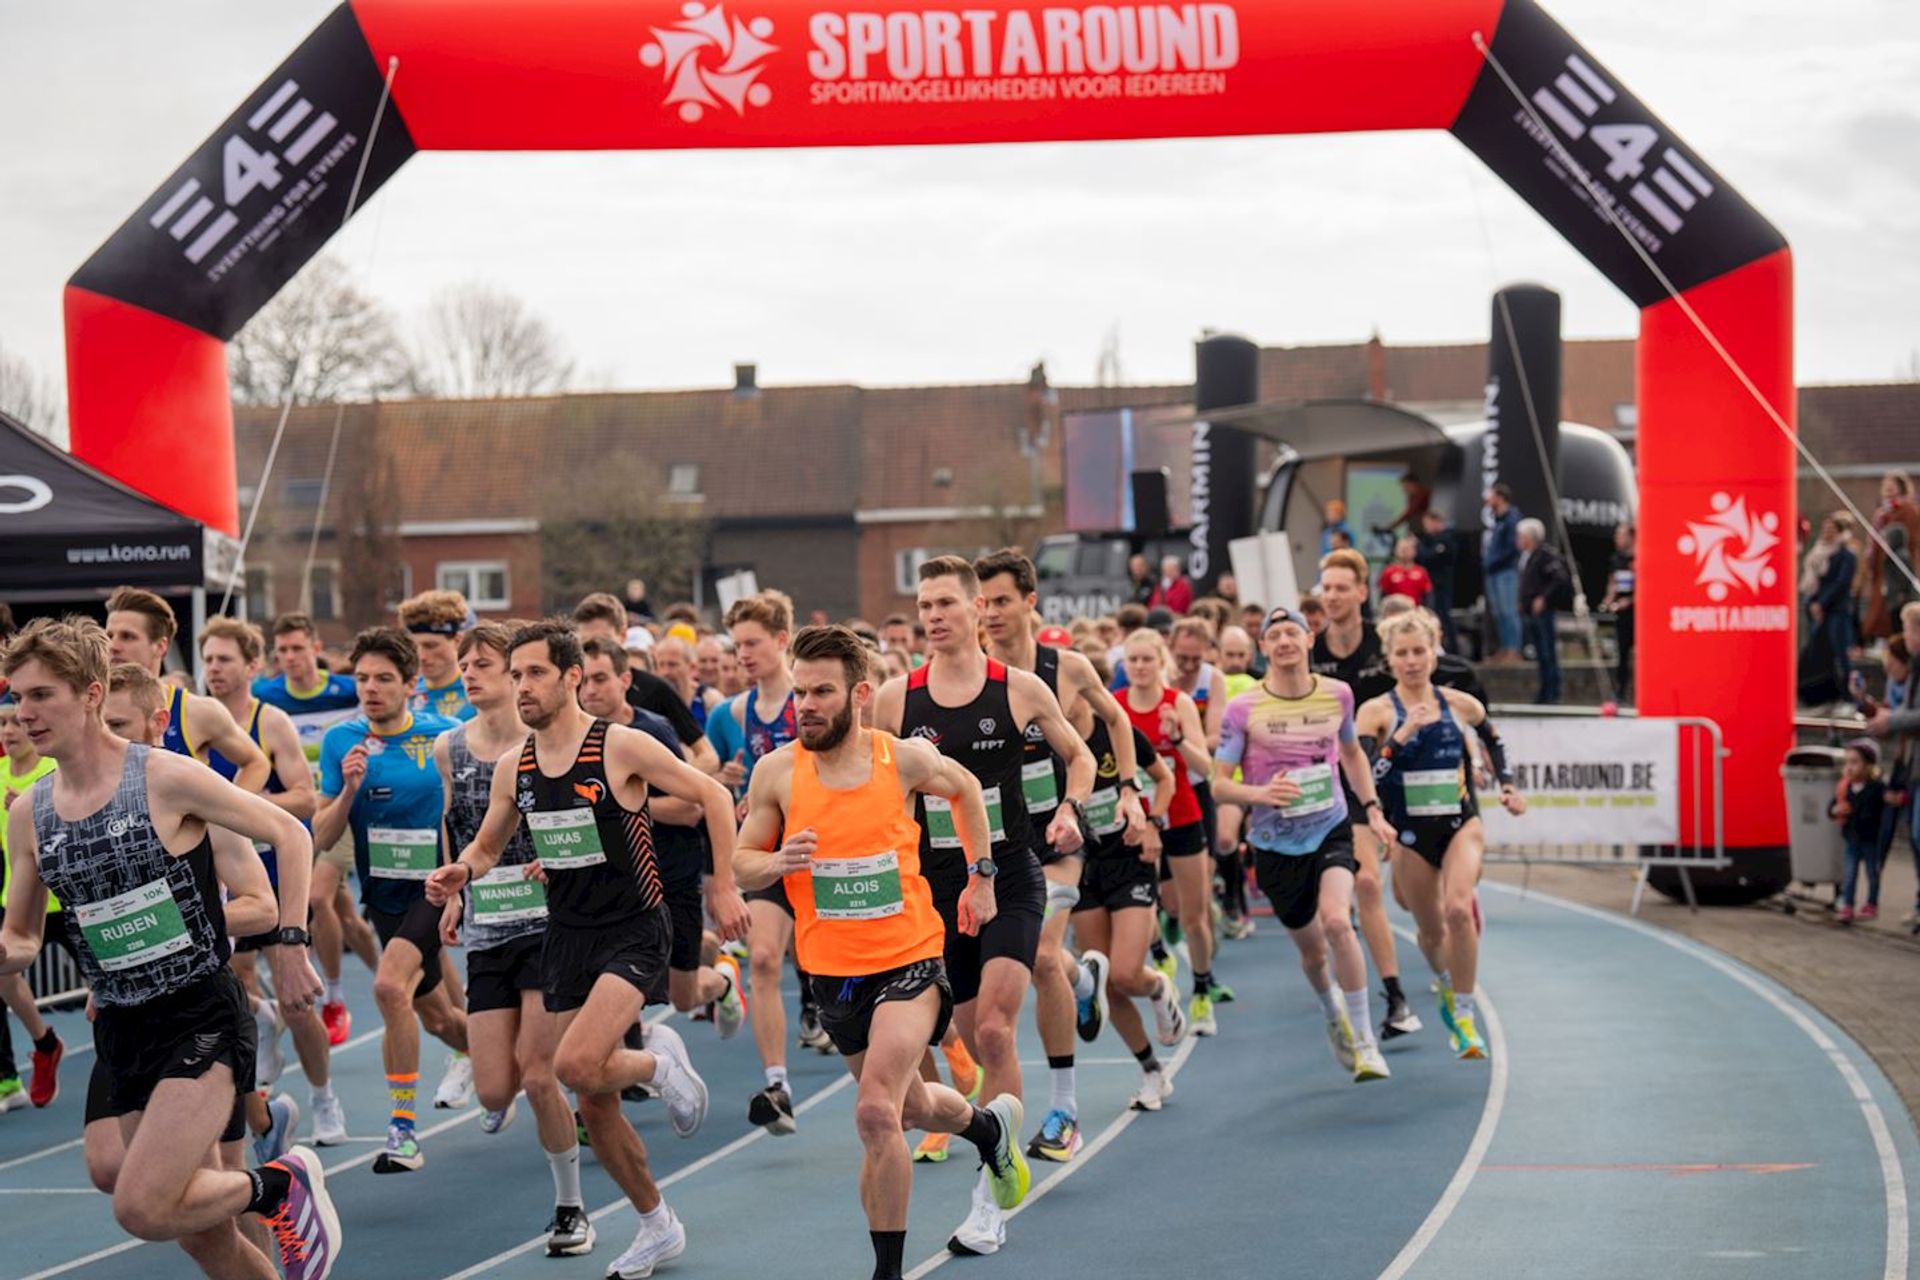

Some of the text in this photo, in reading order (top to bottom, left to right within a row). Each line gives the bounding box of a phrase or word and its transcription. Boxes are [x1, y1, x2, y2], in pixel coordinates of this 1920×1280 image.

[807, 3, 1239, 81] SPORTAROUND
[810, 72, 1226, 104] SPORTMOGELIJKHEDEN VOOR IEDEREEN
[1187, 421, 1211, 580] GARMIN
[67, 544, 190, 563] www.kono.run
[543, 831, 582, 845] LUKAS
[391, 847, 412, 859] TIM
[142, 886, 165, 901] 10K
[480, 884, 533, 901] WANNES
[833, 880, 880, 895] ALOIS
[100, 913, 158, 942] RUBEN
